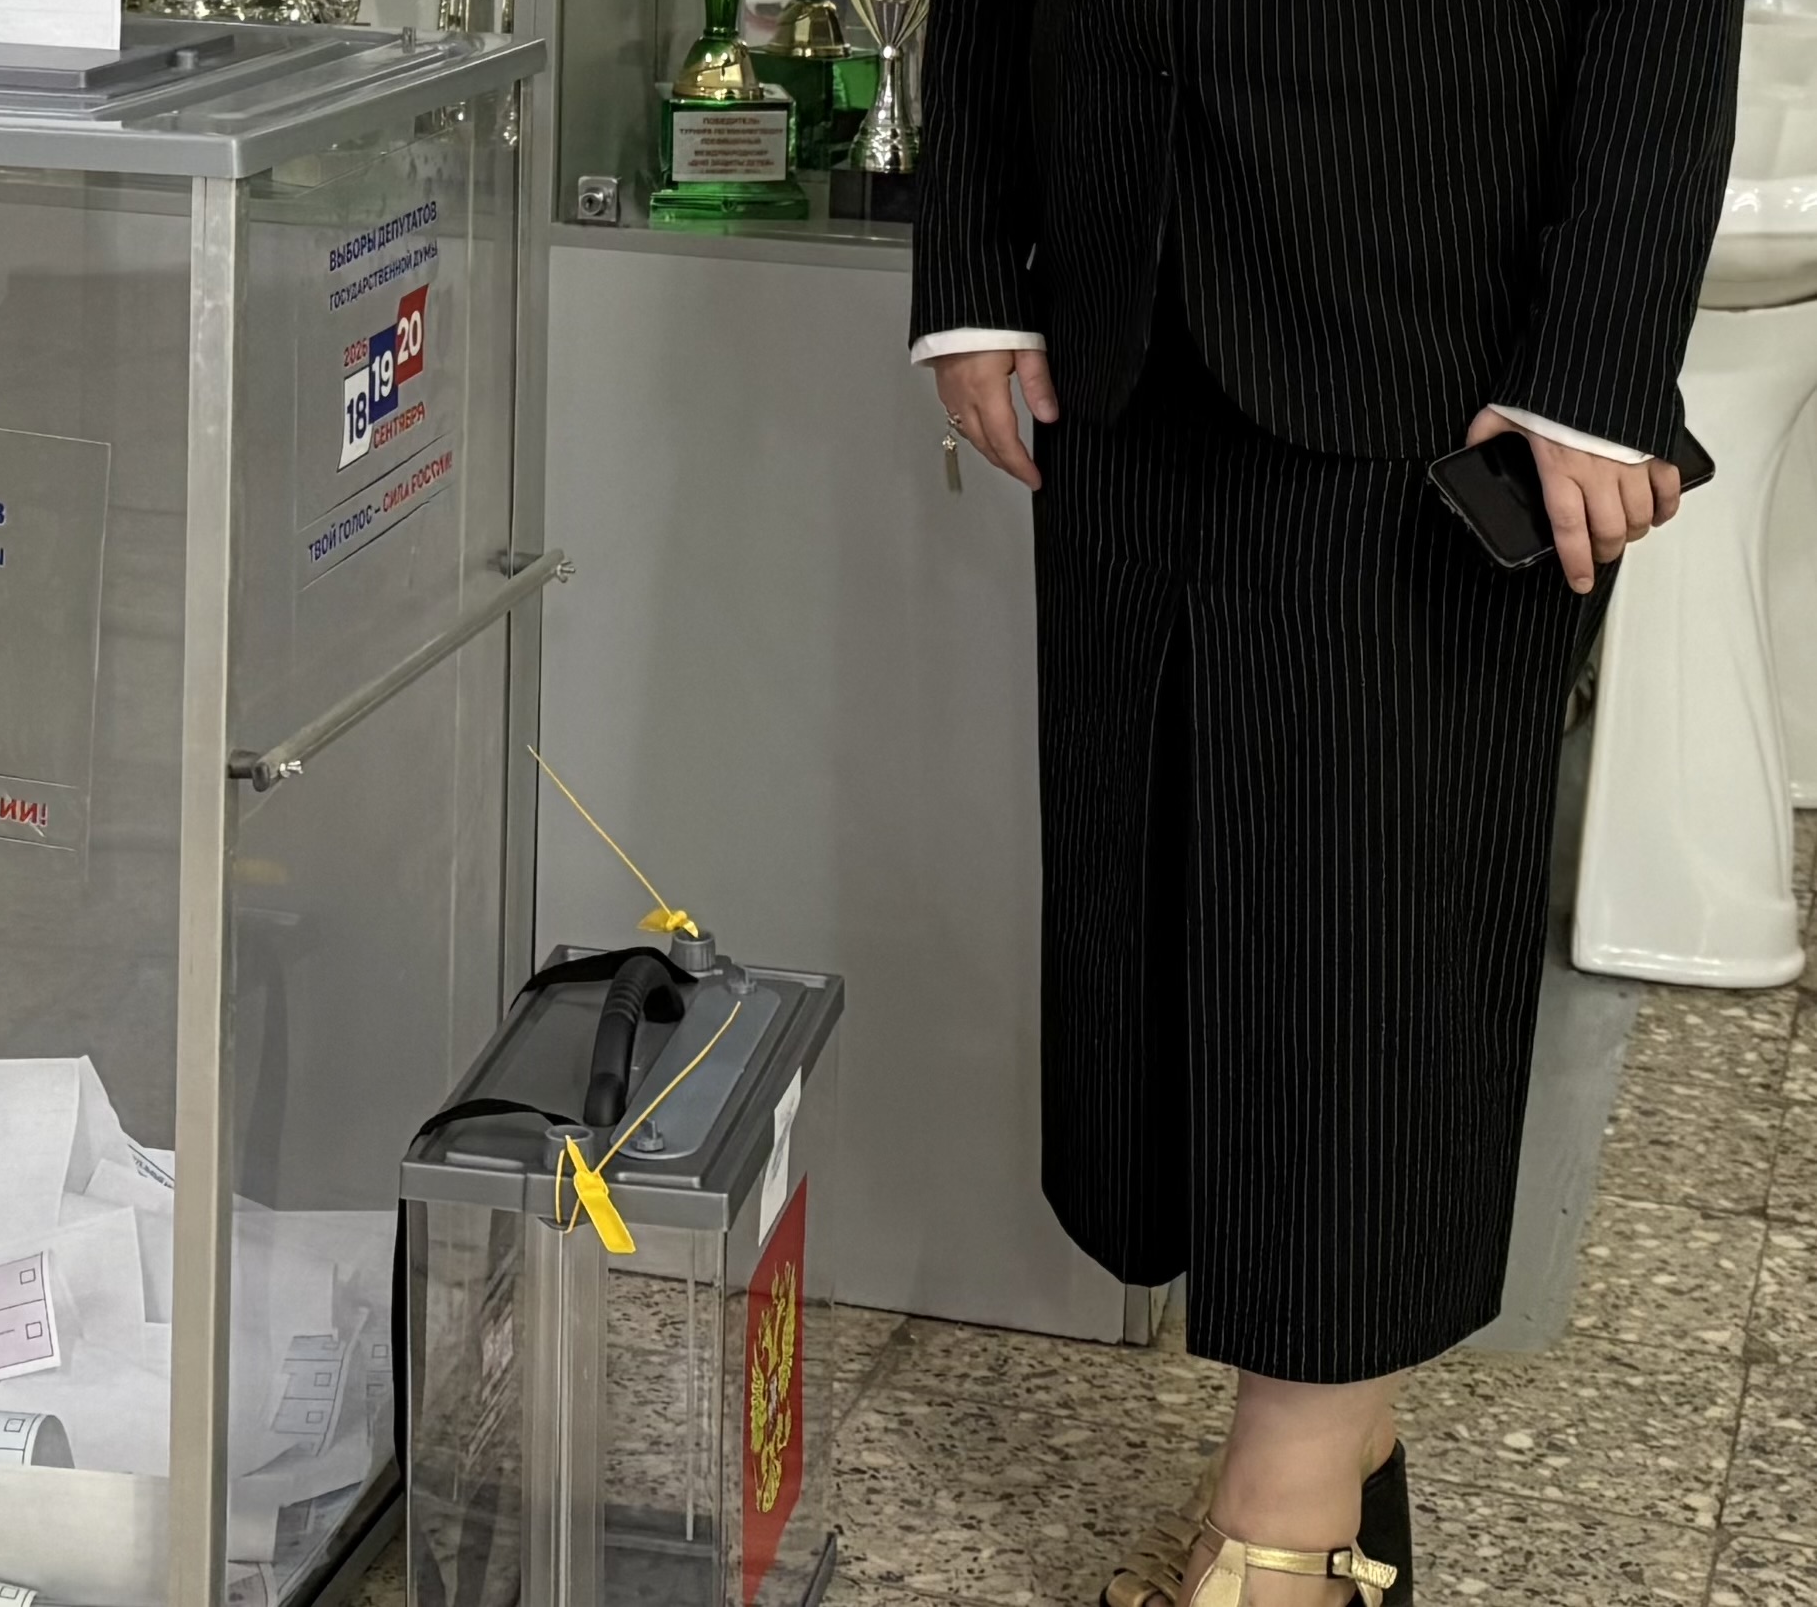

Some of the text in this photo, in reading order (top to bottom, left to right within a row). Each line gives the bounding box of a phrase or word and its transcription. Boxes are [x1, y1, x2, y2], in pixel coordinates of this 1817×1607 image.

[329, 201, 437, 272] ВЫБОРЫ ДЕПУТАТОВ
[329, 240, 438, 311] ГОСУДАРСТВЕННОЙ ДУМЫ
[347, 310, 423, 445] 18 19 20
[373, 401, 426, 449] СЕНТЯБРЯ
[308, 525, 337, 563] ТВОЙ
[338, 505, 373, 543] ГОЛОС
[382, 484, 410, 513] СИЛА
